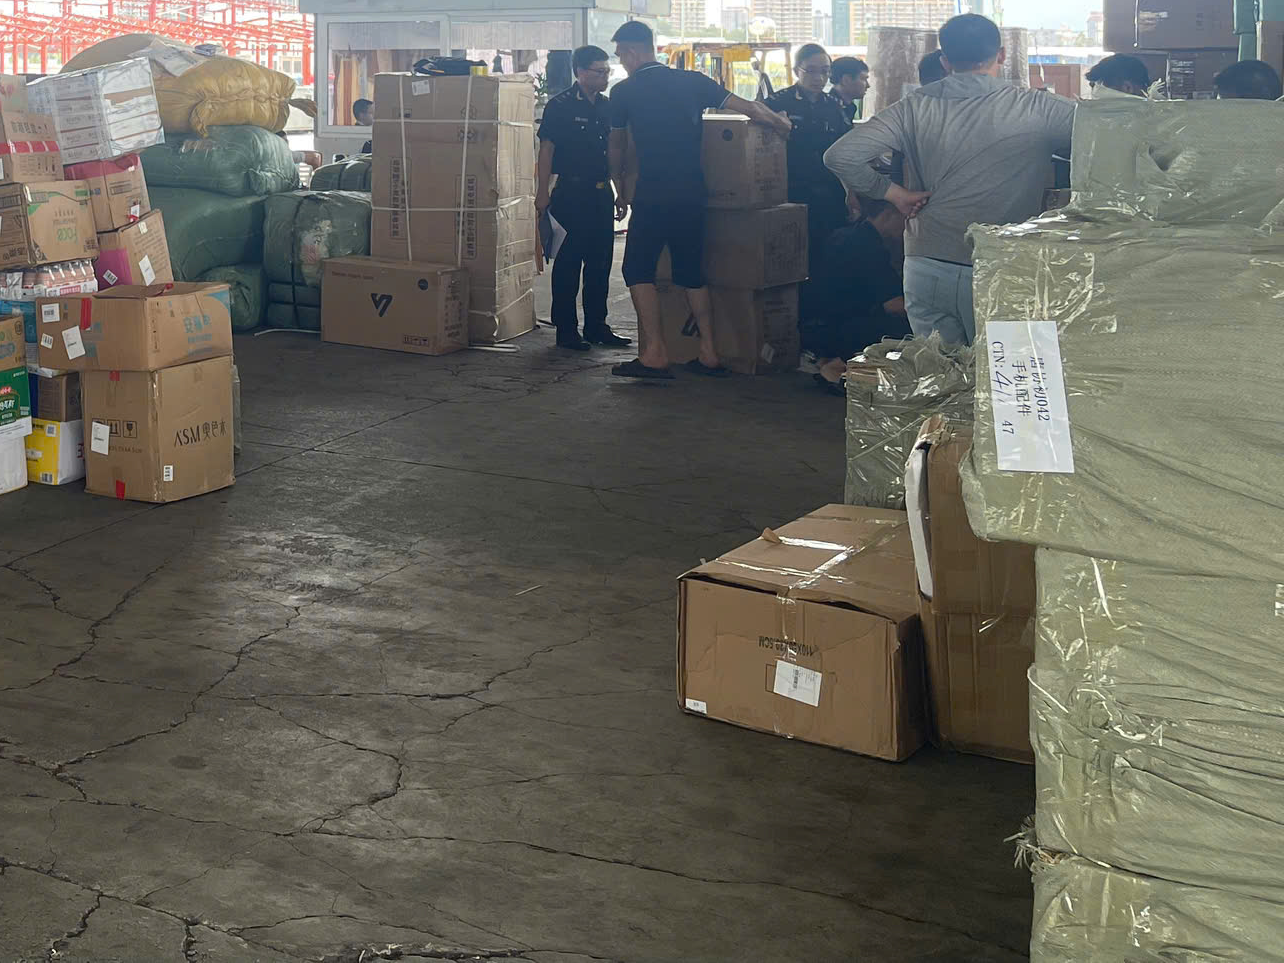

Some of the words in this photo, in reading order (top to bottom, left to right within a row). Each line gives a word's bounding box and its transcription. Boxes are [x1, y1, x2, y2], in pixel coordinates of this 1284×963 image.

[991, 341, 1006, 369] CTN:
[1001, 420, 1015, 435] 47
[1012, 360, 1032, 417] 手机配件
